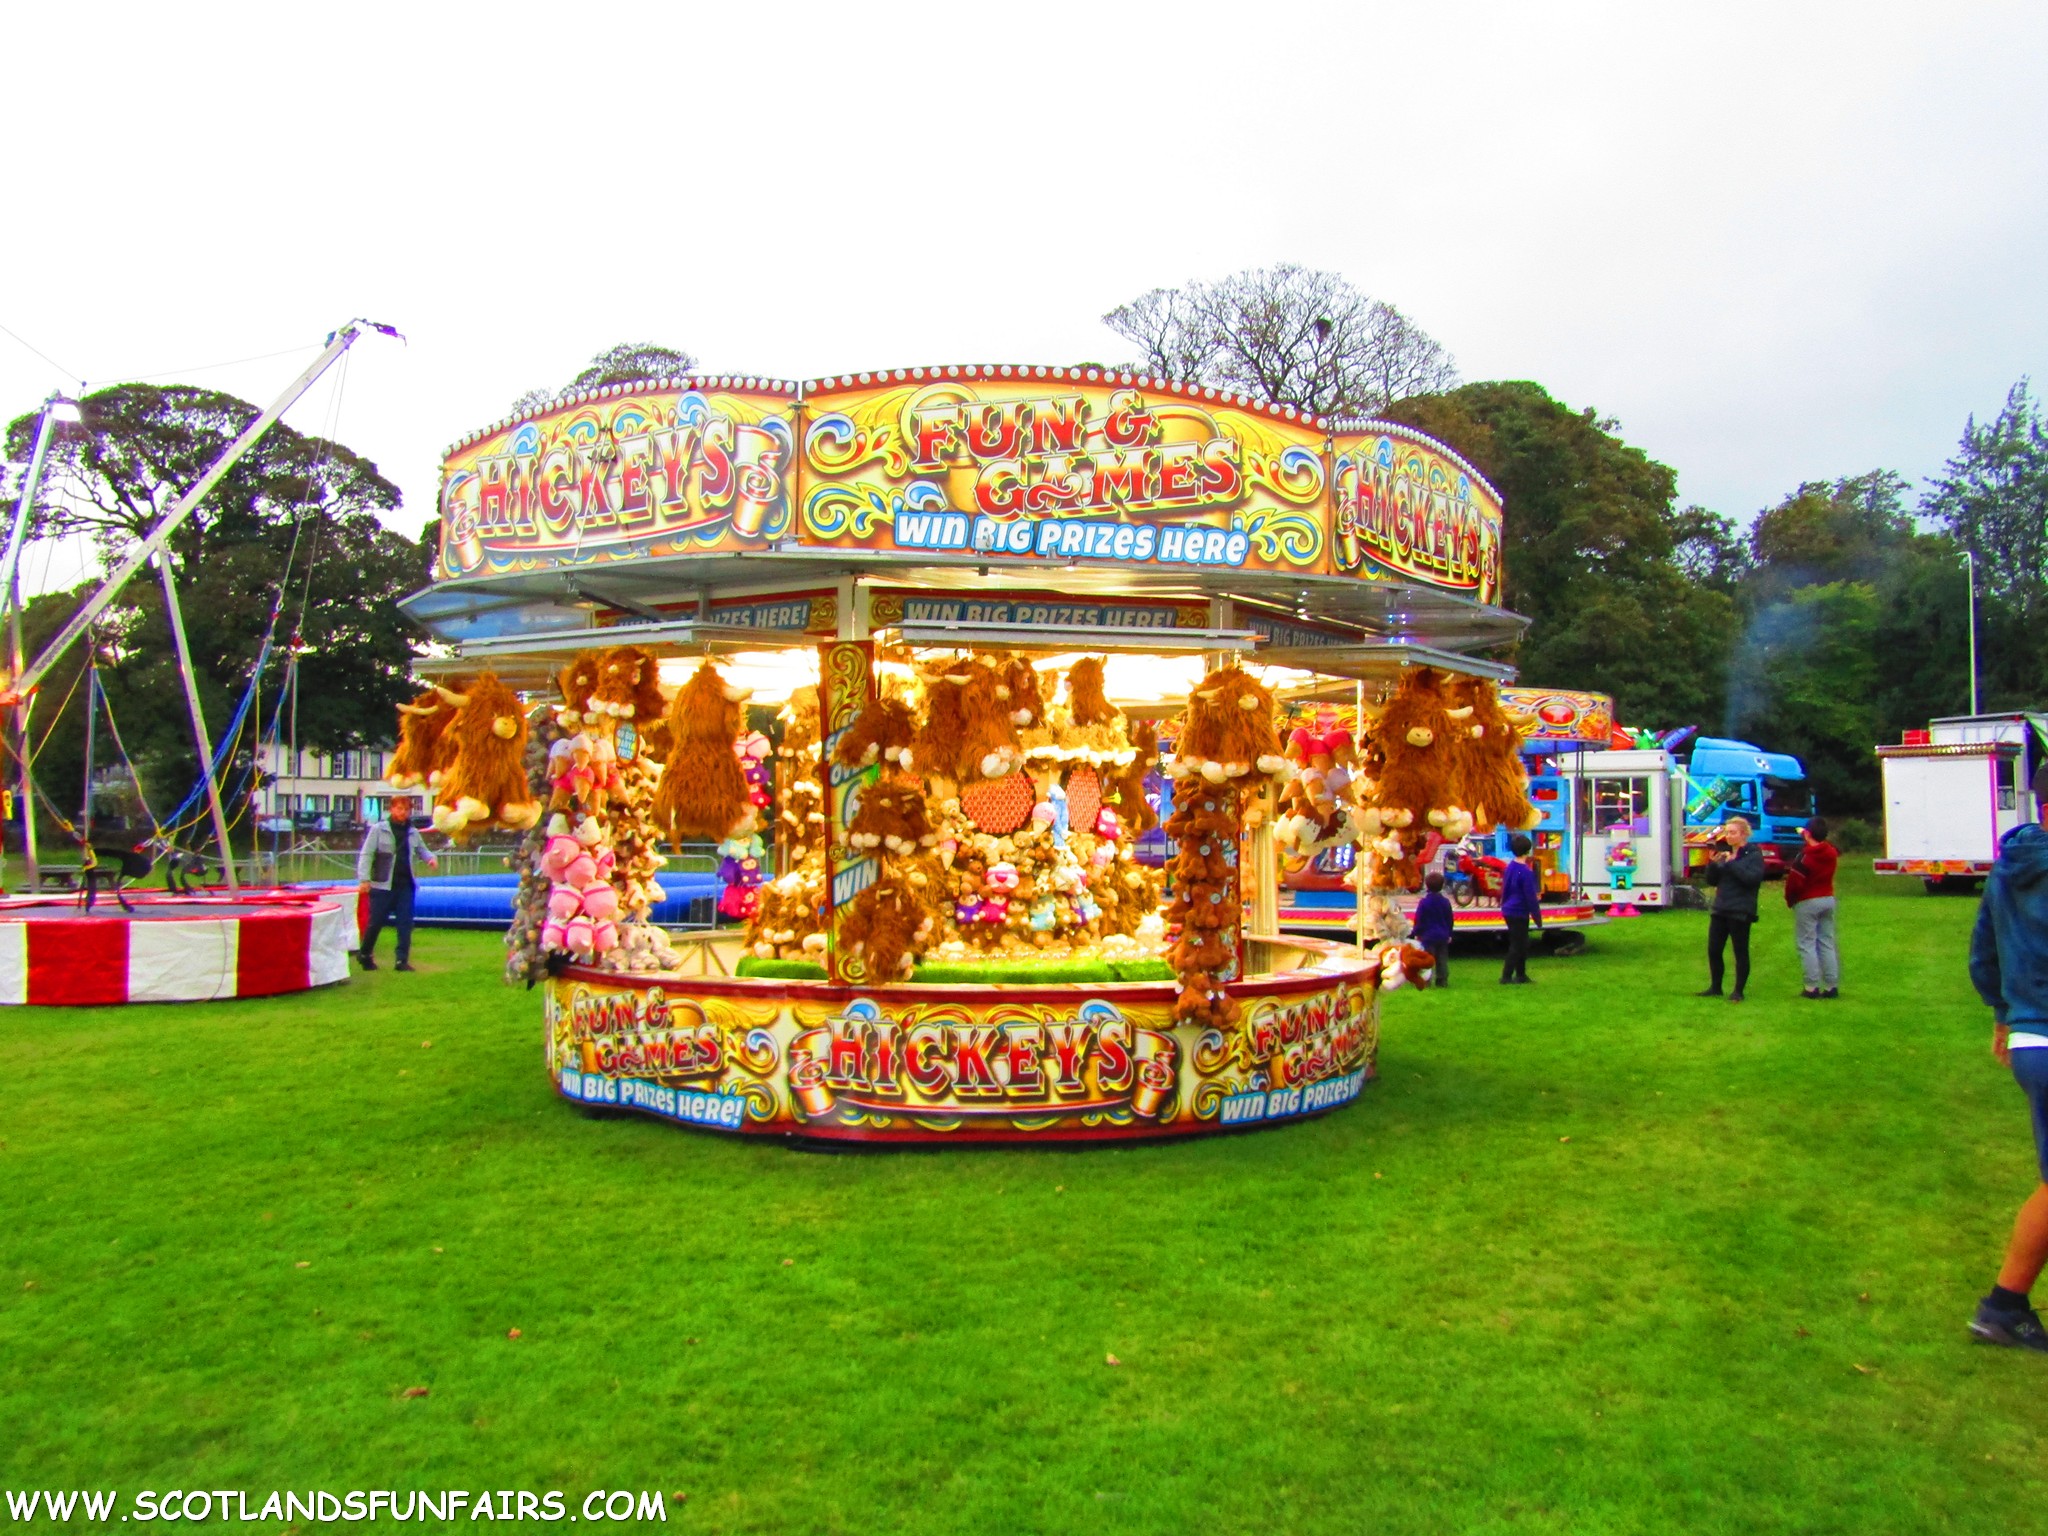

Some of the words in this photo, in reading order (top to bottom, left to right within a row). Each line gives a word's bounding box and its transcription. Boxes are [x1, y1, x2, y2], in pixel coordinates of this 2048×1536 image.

[911, 393, 1089, 474] FUN
[1103, 388, 1159, 451] &
[973, 437, 1244, 524] GAMES
[897, 514, 968, 546] WIN
[976, 518, 1032, 550] BIG
[1040, 520, 1153, 559] PRIZES
[754, 604, 808, 628] HERE!
[907, 602, 961, 621] WIN
[966, 604, 1009, 623] BIG
[1015, 606, 1099, 626] PRIZES
[1105, 610, 1174, 628] HERE!
[1273, 627, 1291, 646] BIG
[834, 857, 878, 904] WIN
[574, 989, 638, 1044] FUN
[1252, 991, 1331, 1064] FUN
[595, 1021, 724, 1079] GAMES
[584, 1075, 616, 1100] BIG
[620, 1080, 676, 1115] PRIZES
[1223, 1093, 1265, 1122] WIN
[1267, 1090, 1301, 1116] BIG
